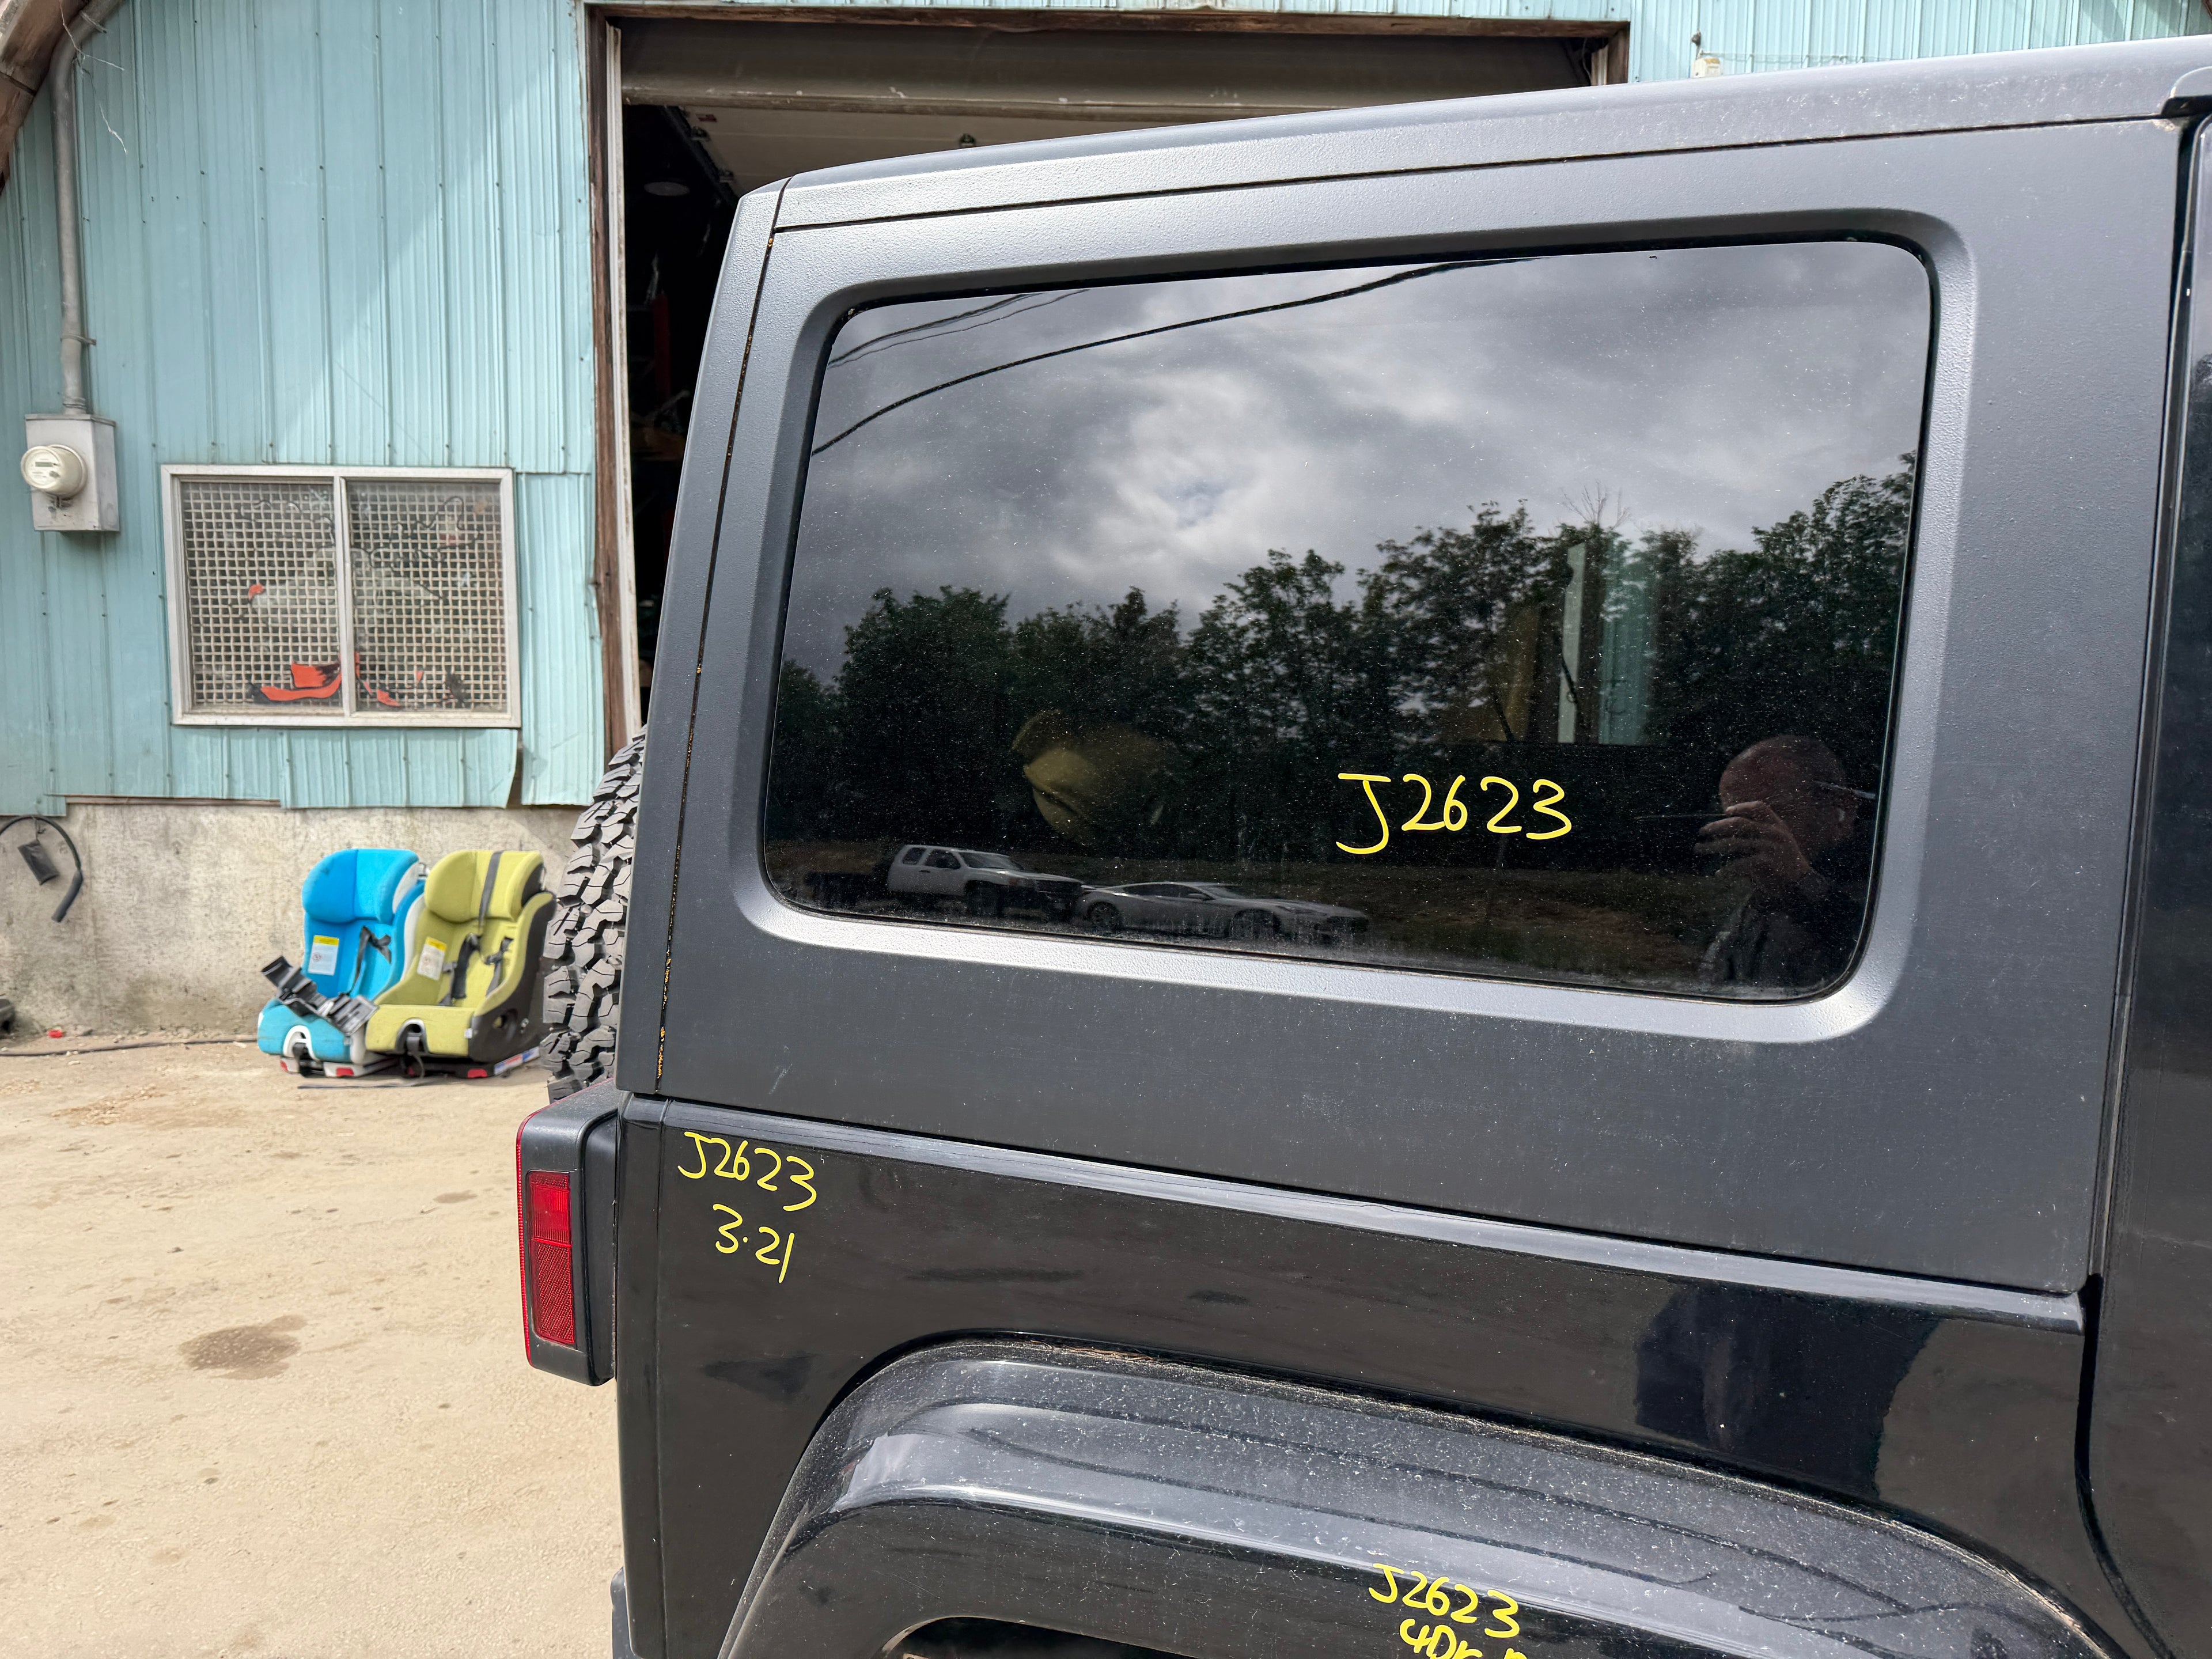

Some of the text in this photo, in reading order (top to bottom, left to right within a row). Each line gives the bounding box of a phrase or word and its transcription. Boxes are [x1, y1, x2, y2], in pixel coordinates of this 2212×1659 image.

[1336, 773, 1572, 855] J2623
[677, 1131, 817, 1211] J2623
[1368, 1563, 1520, 1638] J2623
